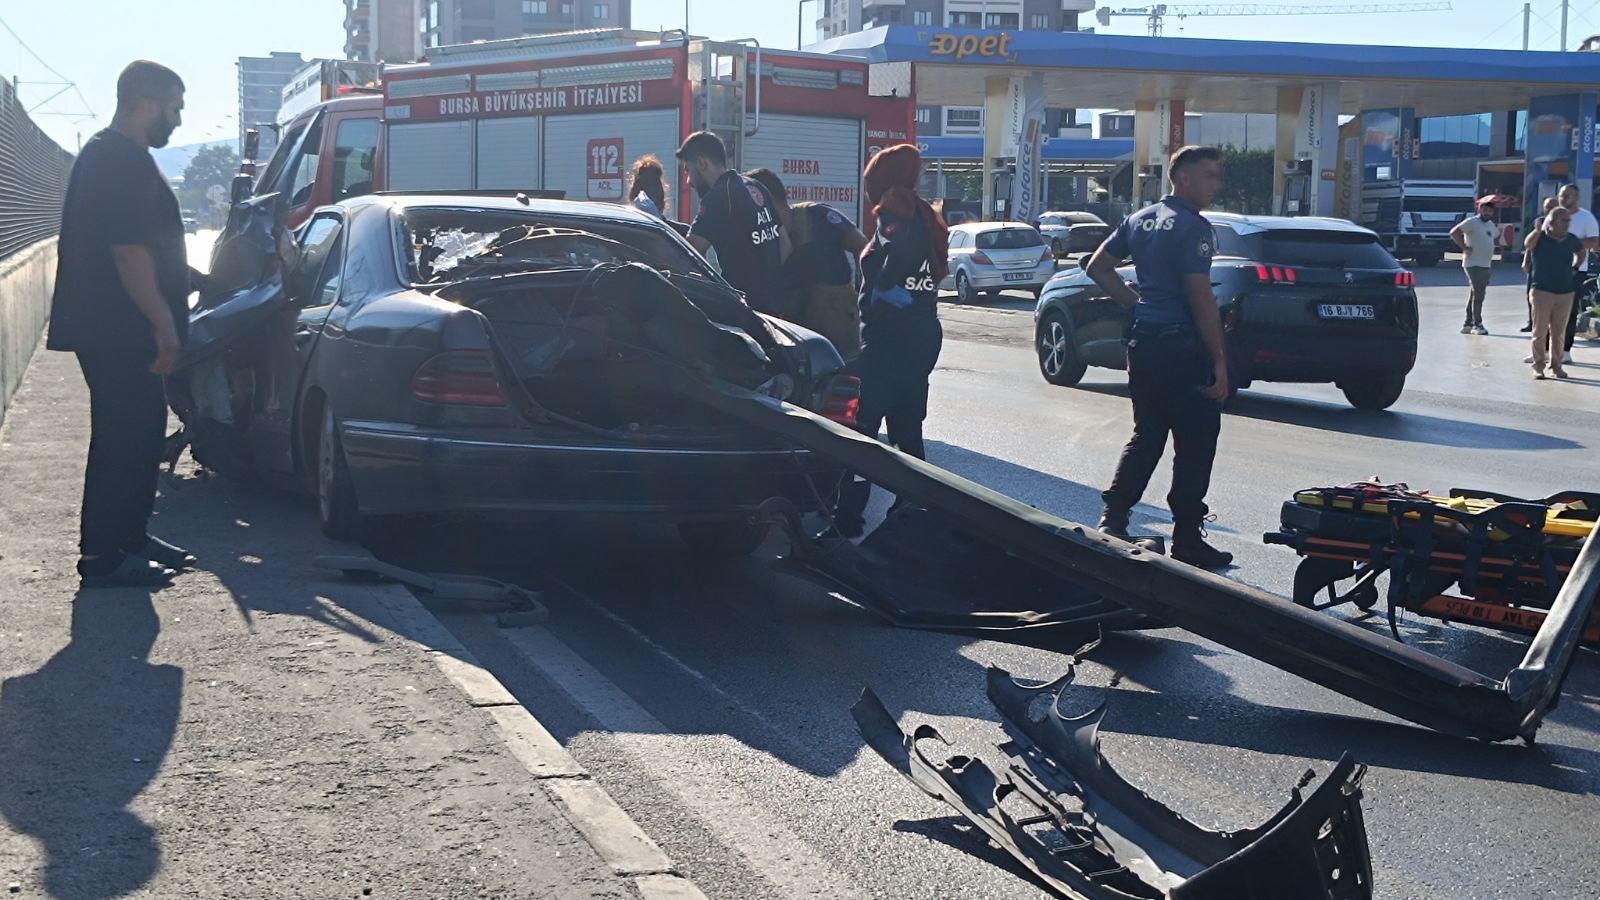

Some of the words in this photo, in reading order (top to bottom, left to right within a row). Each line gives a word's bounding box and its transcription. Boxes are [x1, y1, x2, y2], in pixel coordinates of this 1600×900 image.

[928, 33, 1011, 61] opet
[440, 98, 479, 115] BURSA
[485, 88, 567, 113] BÜYÜKŞEHİR
[574, 81, 643, 107] İTFAİYESİ
[592, 145, 618, 175] 112
[782, 158, 820, 175] BURSA
[810, 184, 853, 202] İTFAİYESİ
[1323, 305, 1334, 316] 16
